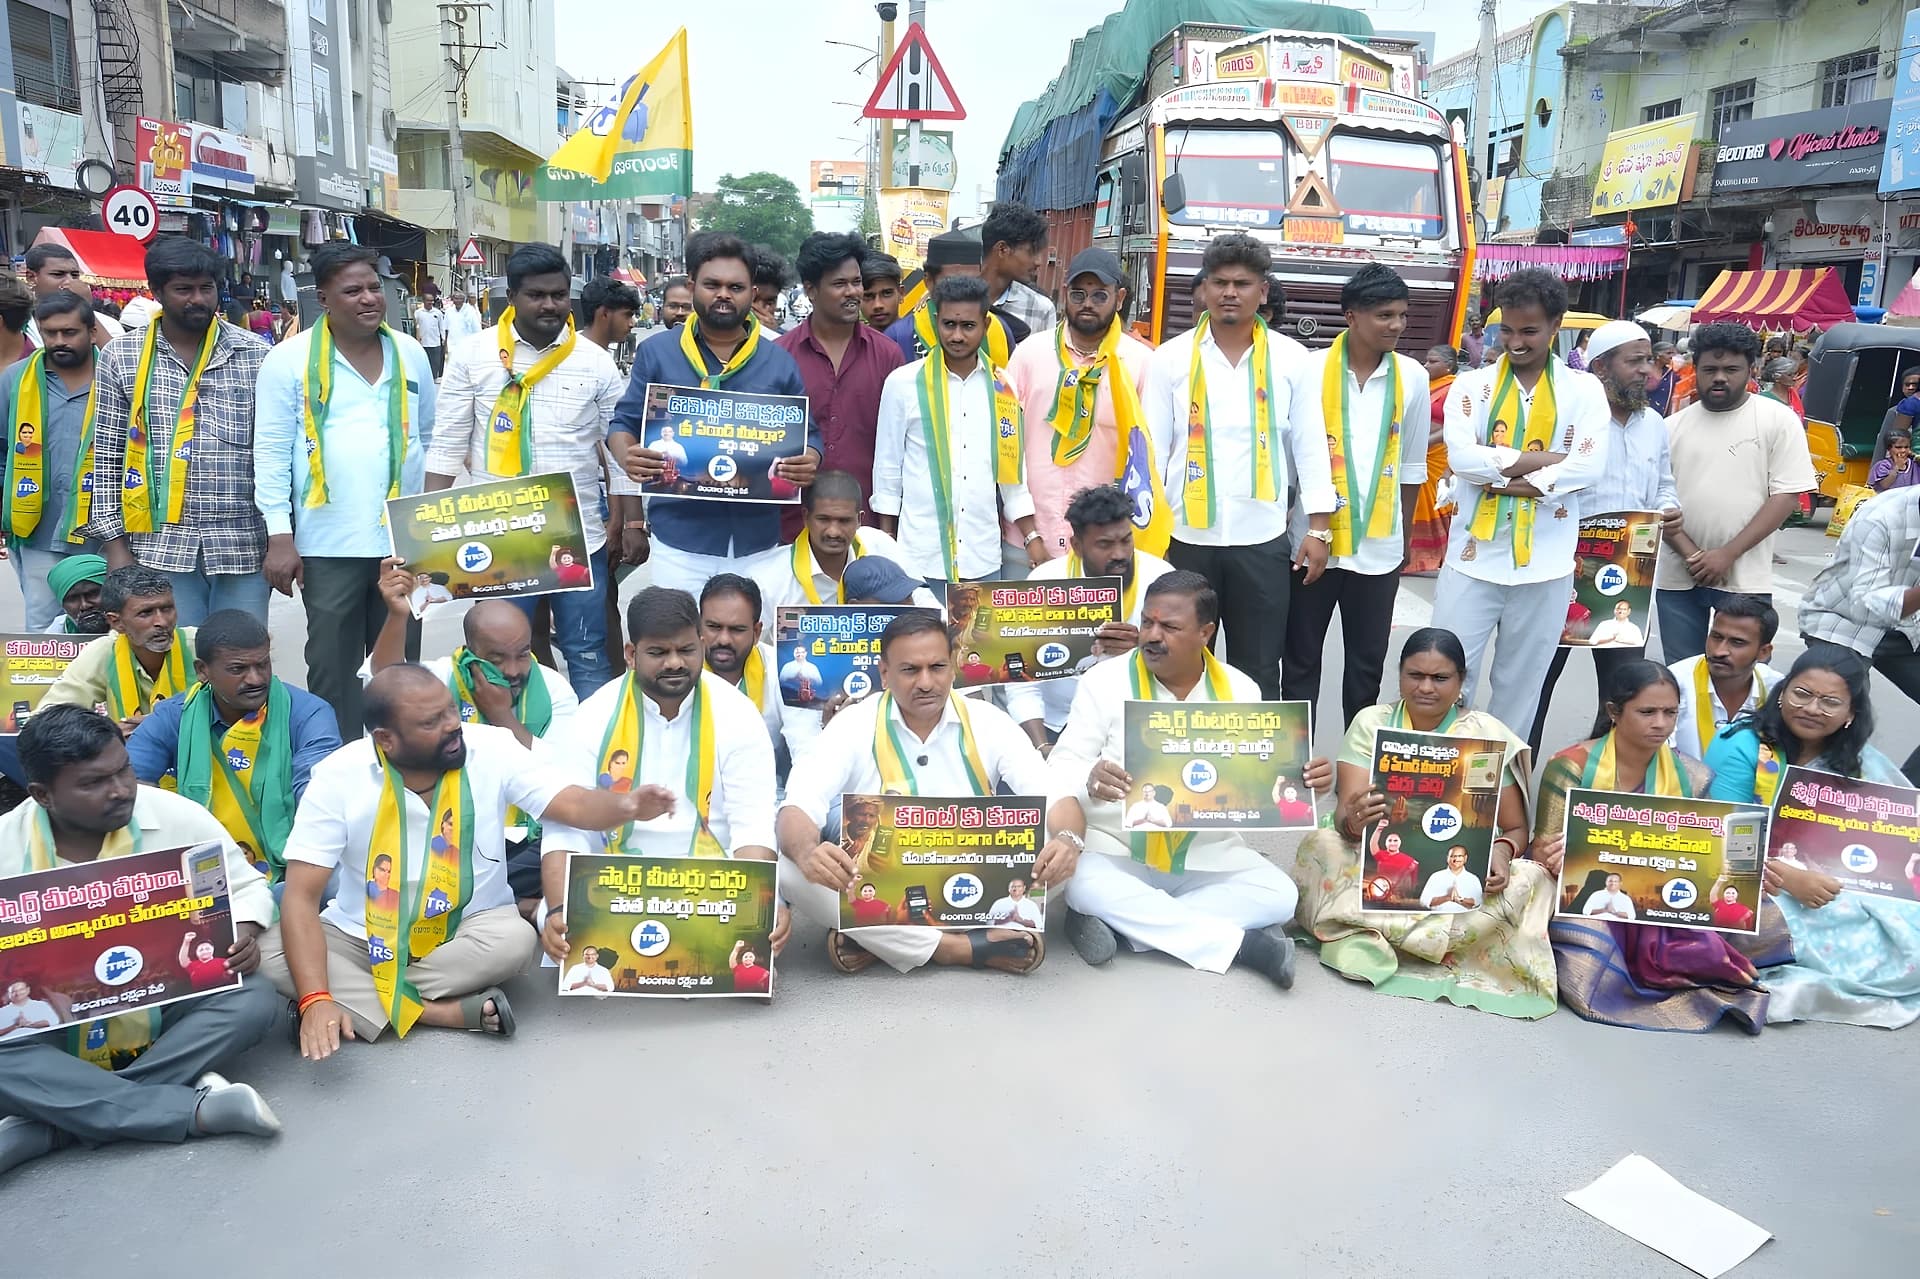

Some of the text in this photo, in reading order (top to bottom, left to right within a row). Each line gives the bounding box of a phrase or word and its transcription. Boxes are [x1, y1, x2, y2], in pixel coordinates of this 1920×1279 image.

[1788, 131, 1835, 161] Officer's
[1836, 124, 1881, 151] Choice
[114, 205, 149, 226] 40
[894, 805, 1040, 828] కరెంట్ కు కూడా
[42, 880, 111, 911] మీటర్లు
[598, 865, 747, 898] స్మార్ట్ మీటర్లు వద్దు
